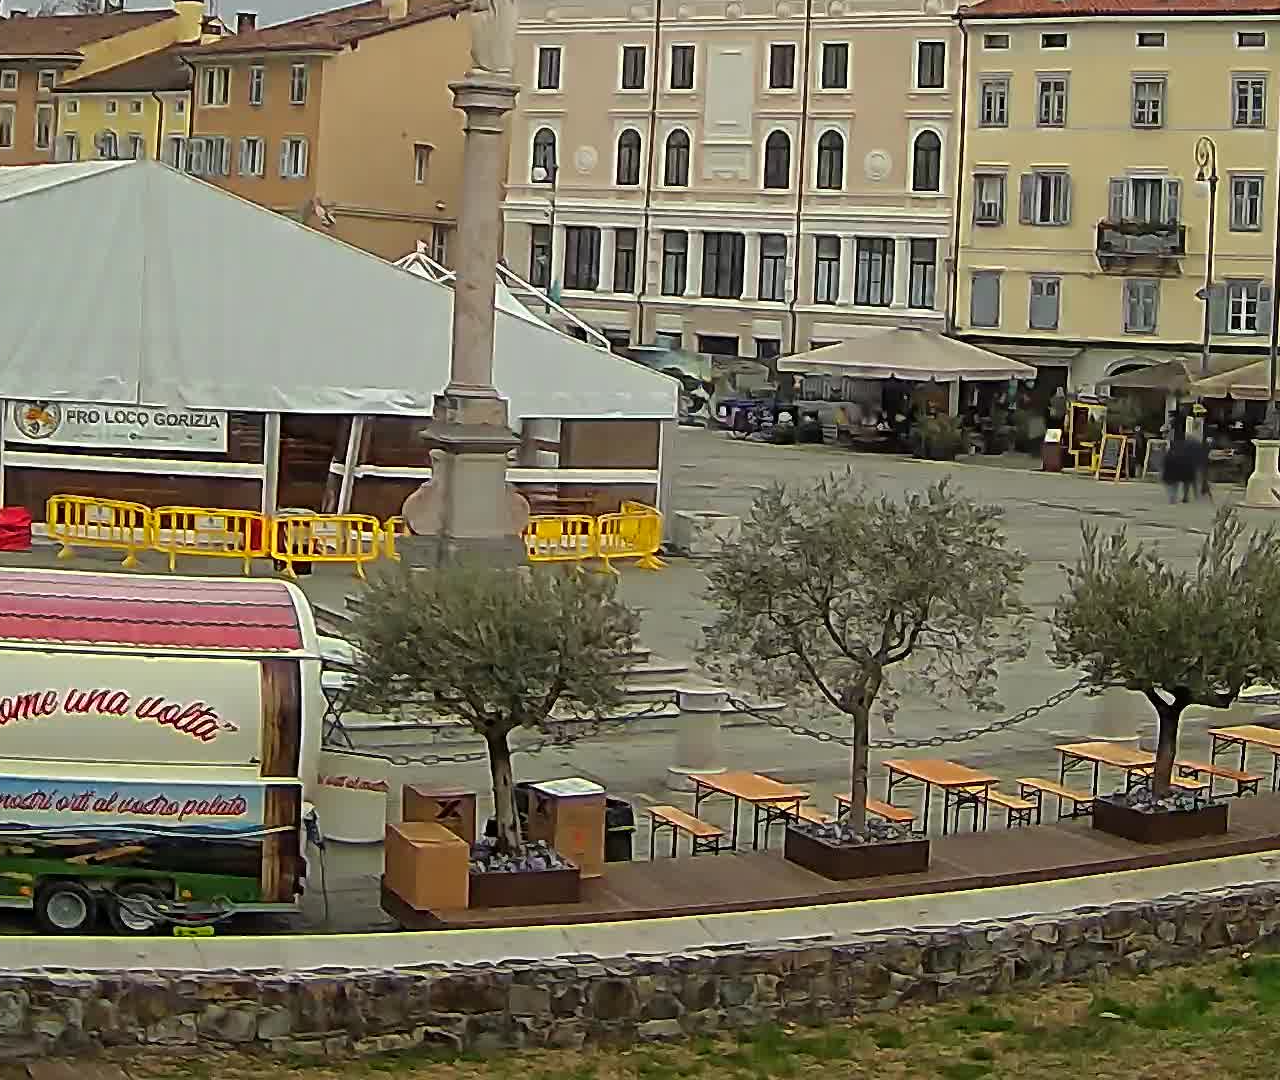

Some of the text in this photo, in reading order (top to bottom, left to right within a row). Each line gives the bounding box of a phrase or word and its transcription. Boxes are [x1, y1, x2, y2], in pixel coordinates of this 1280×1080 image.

[66, 408, 220, 428] PRO LOCO GORIZIA
[63, 688, 131, 715] una
[56, 789, 94, 812] orti
[94, 792, 118, 813] al
[119, 795, 179, 816] vostro
[178, 795, 246, 821] palato
